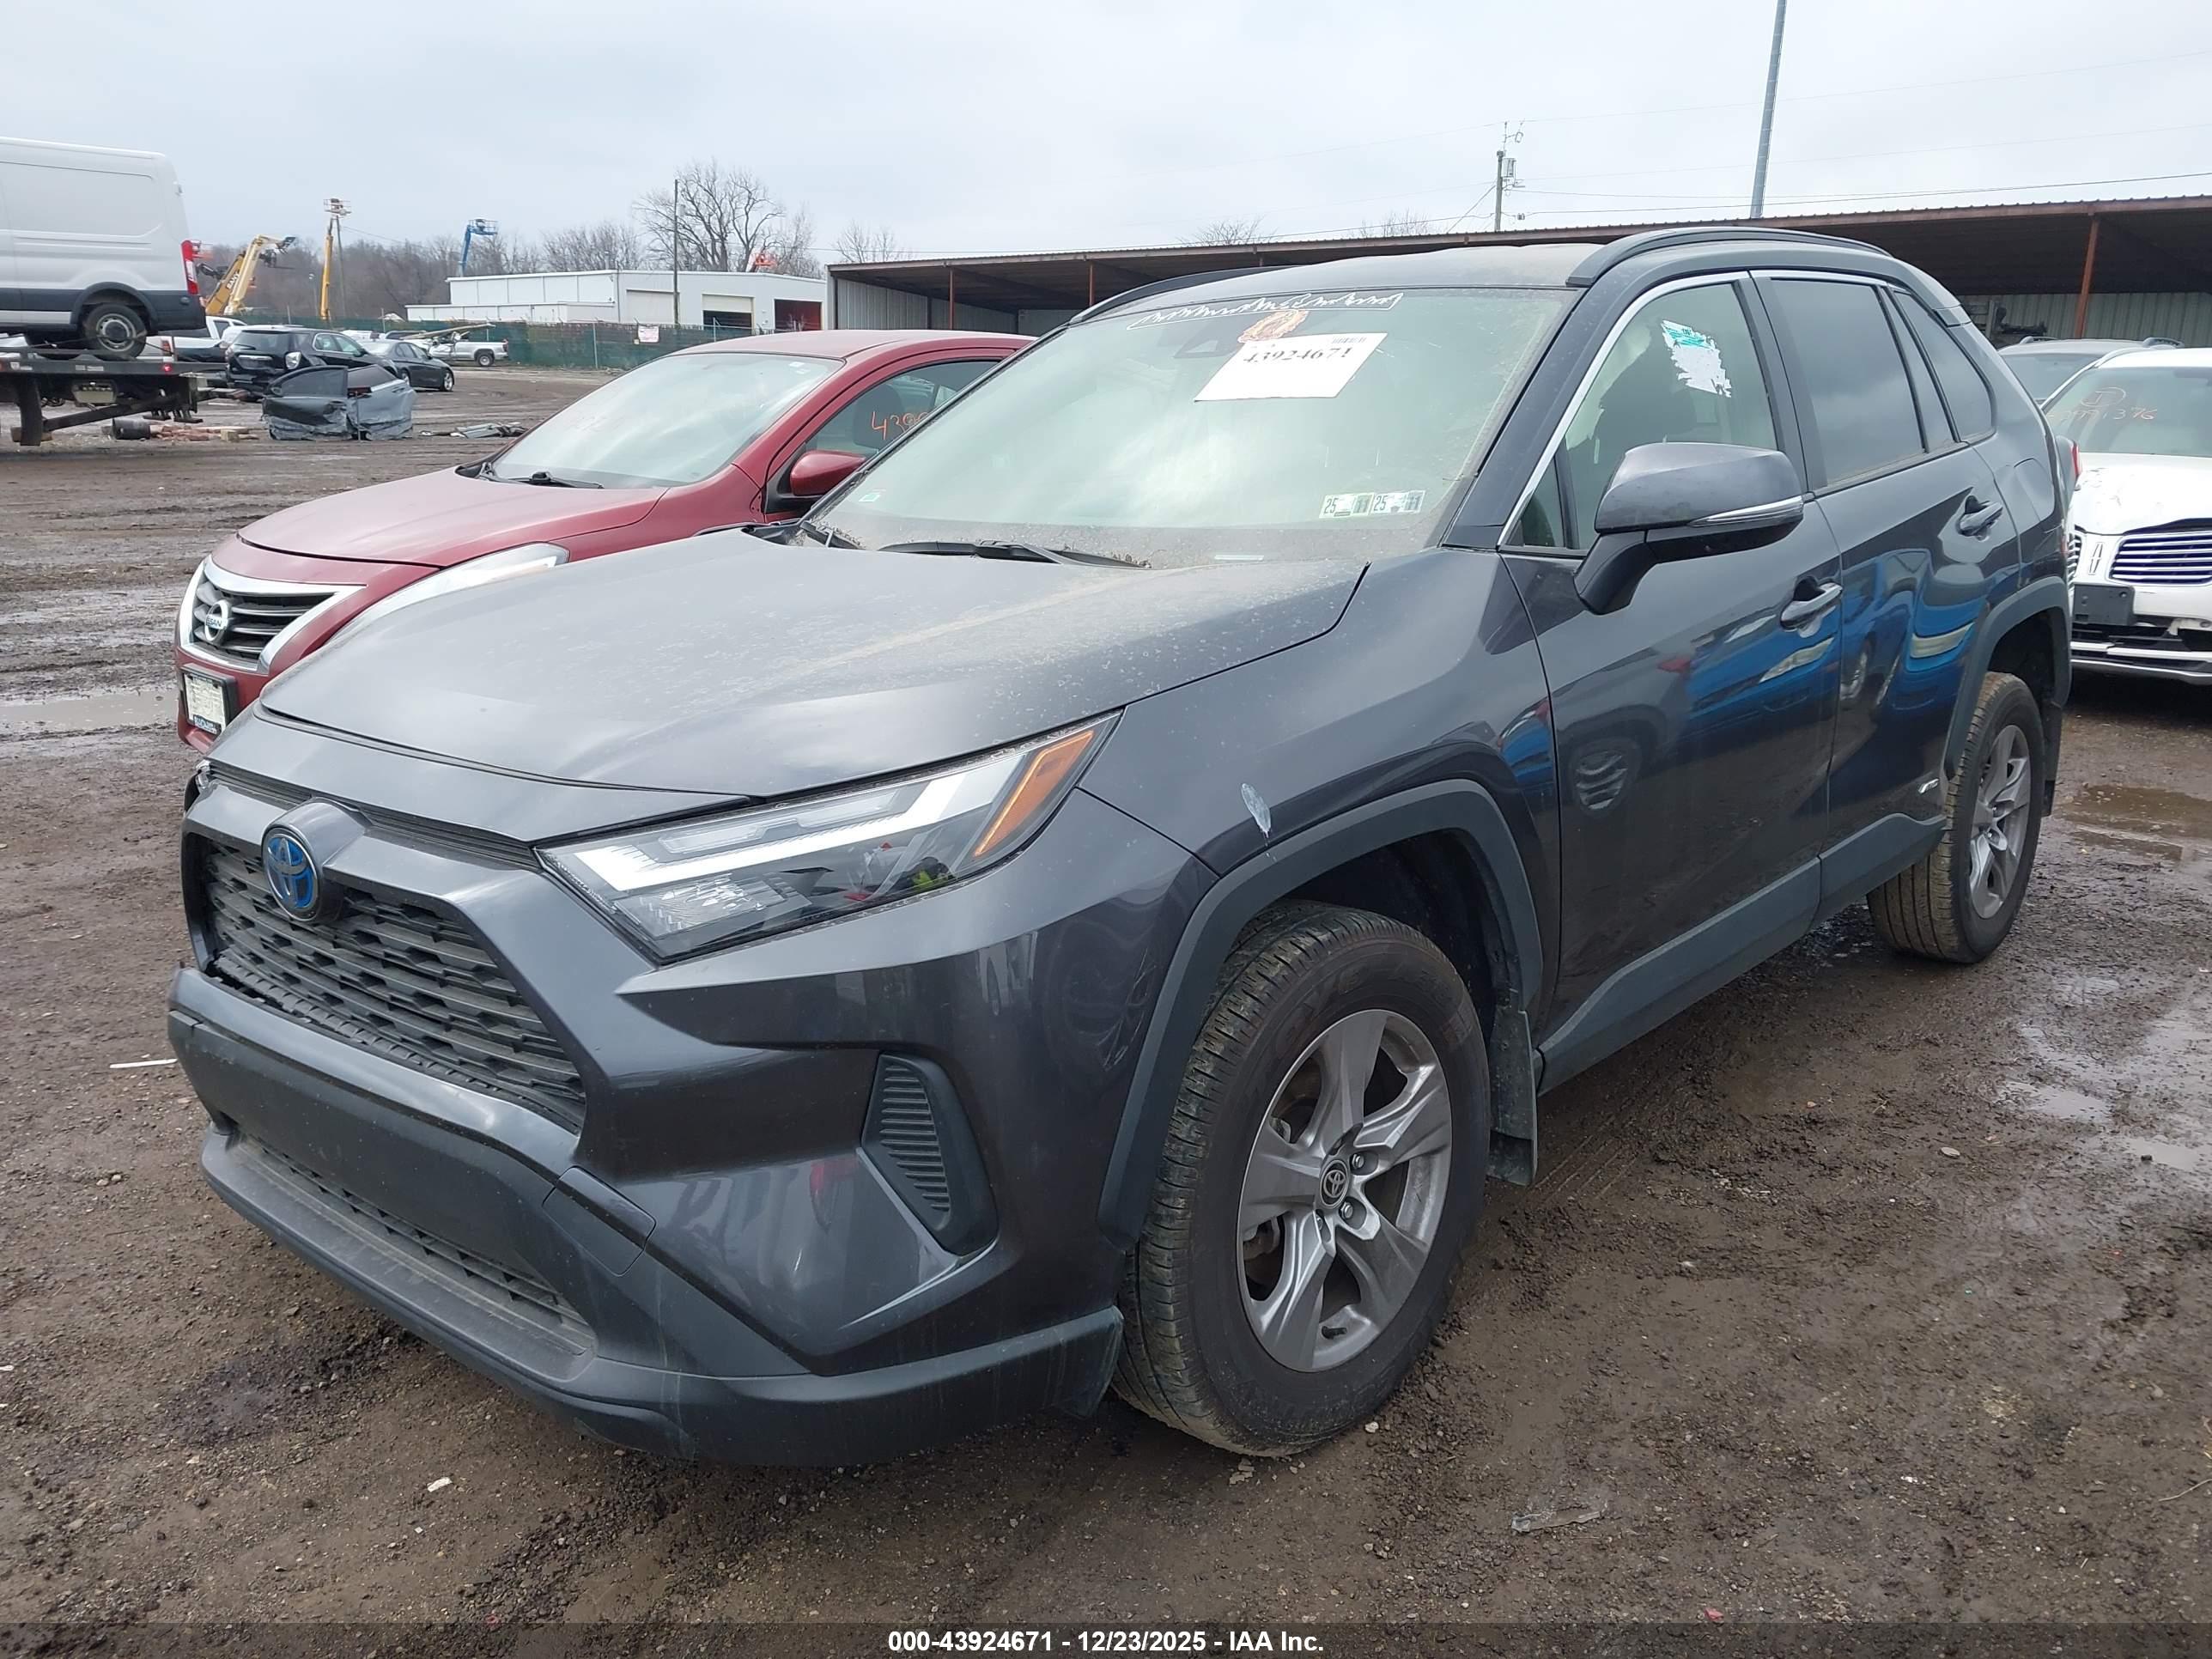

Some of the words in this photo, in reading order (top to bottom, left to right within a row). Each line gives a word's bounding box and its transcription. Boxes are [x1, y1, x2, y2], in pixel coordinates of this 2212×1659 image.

[1243, 347, 1352, 363] 43924671
[1323, 497, 1339, 514] 25
[1374, 495, 1388, 511] 25
